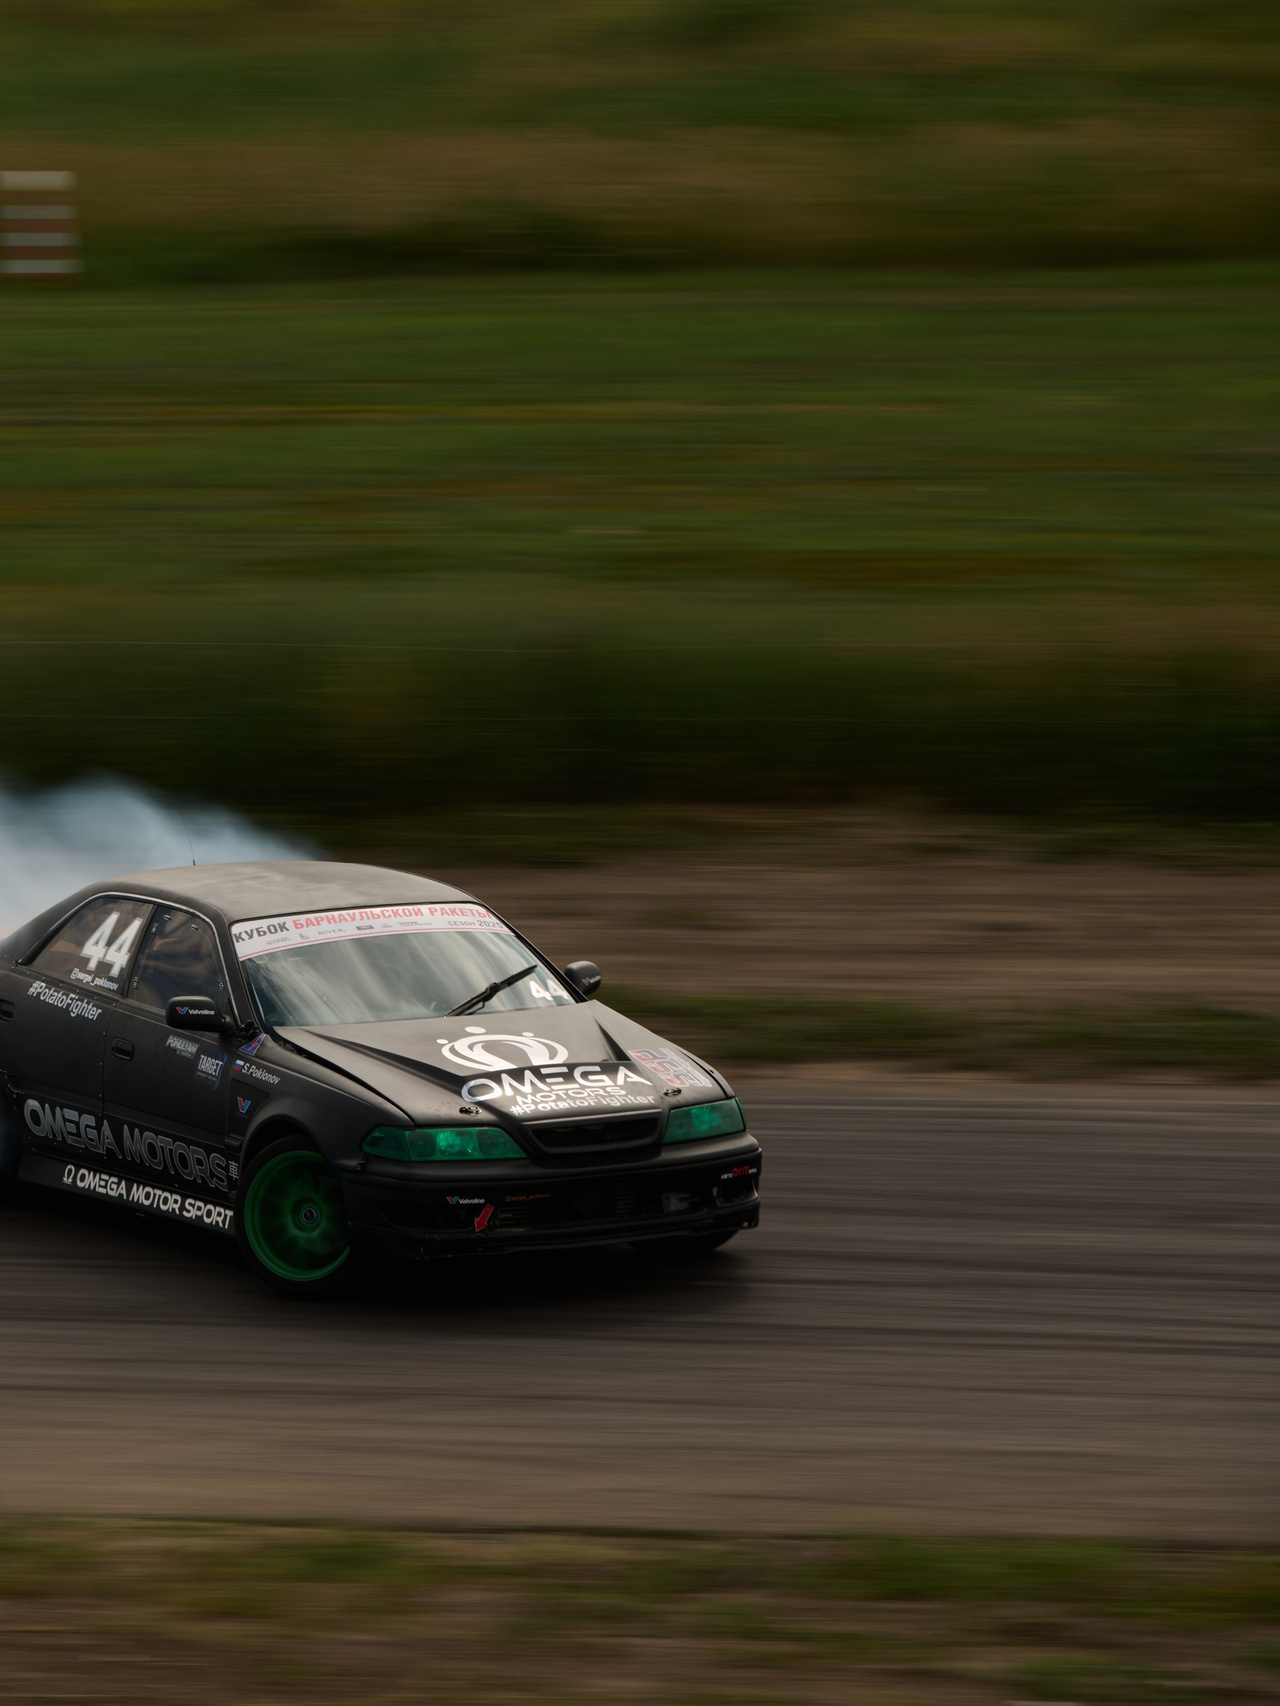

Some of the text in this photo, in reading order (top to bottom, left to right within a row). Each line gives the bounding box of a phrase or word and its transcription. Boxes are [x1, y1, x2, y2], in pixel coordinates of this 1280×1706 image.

[233, 922, 290, 943] КУБОК
[292, 906, 424, 930] БАРНАУЛЬСКОЙ
[426, 907, 493, 919] РАКЕТЫ
[80, 911, 143, 978] 44
[27, 980, 102, 1020] #PotatoFighter
[529, 979, 570, 1001] 44
[188, 1008, 215, 1016] Valvoline
[198, 1055, 223, 1077] TARGET
[242, 1063, 280, 1085] S.Poklonov
[461, 1065, 654, 1103] OMEGA
[515, 1086, 627, 1106] MOTORS
[510, 1094, 656, 1117] #PotatoFighter
[24, 1098, 123, 1159] OMEGA
[123, 1124, 229, 1192] MOTORS
[76, 1168, 127, 1200] OMEGA
[129, 1183, 180, 1215] MOTOR
[182, 1198, 234, 1230] SPORT
